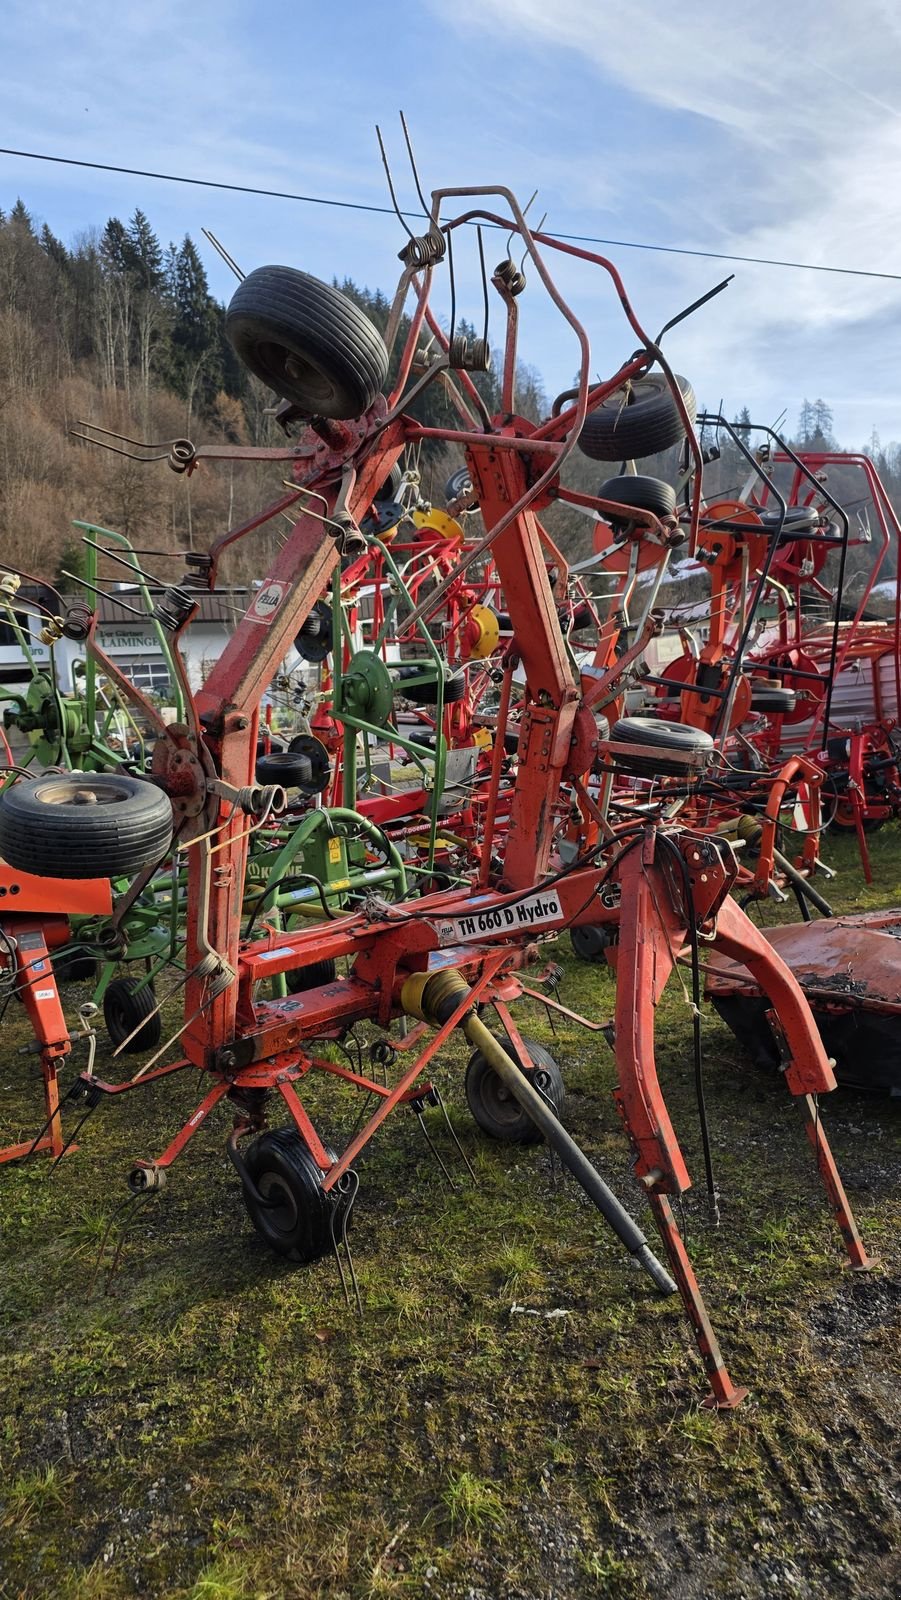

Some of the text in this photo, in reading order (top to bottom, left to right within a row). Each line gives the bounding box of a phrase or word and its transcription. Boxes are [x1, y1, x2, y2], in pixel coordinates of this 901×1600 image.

[101, 636, 160, 648] LAIMINGE
[261, 865, 303, 879] KNE
[458, 899, 558, 935] TH 660 D Hydro
[441, 926, 454, 934] FELLA
